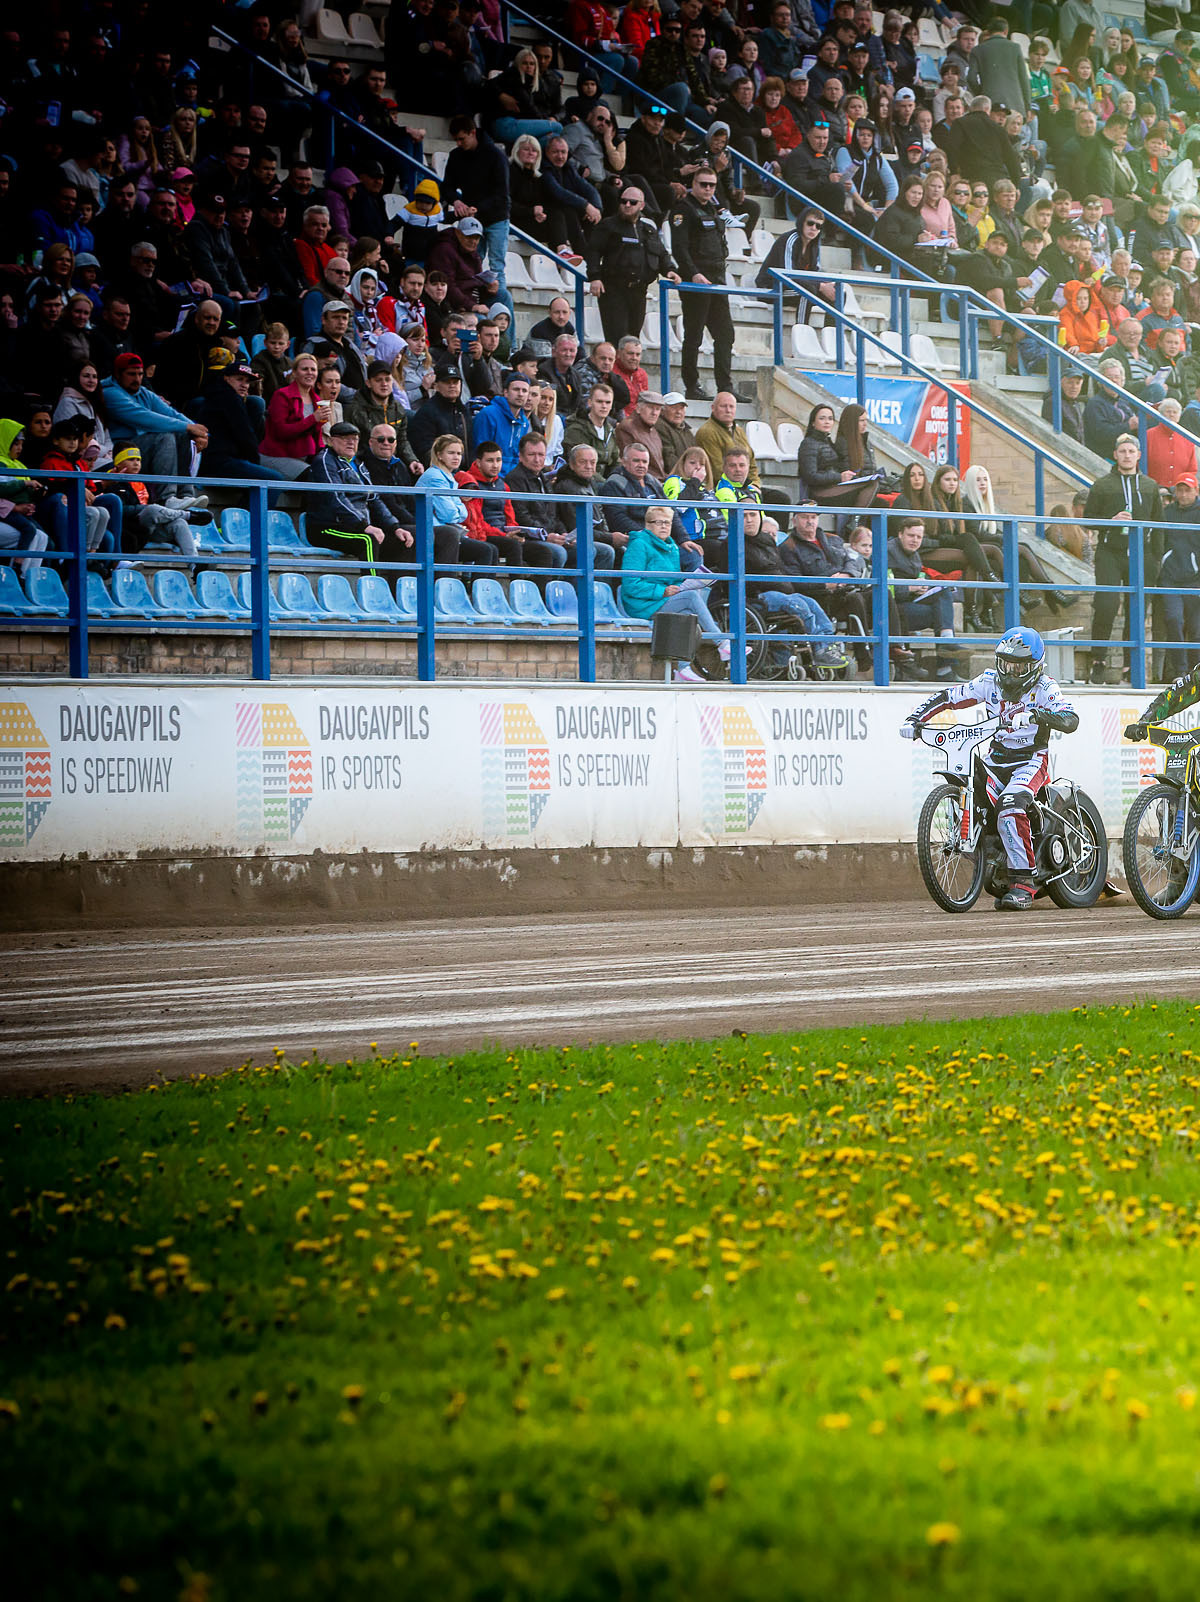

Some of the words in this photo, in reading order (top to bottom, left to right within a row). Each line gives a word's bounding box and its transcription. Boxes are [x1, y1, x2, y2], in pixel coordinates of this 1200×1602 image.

[60, 705, 180, 742] DAUGAVPILS
[320, 705, 429, 740] DAUGAVPILS
[556, 706, 656, 740] DAUGAVPILS
[772, 708, 867, 740] DAUGAVPILS
[948, 728, 984, 740] OPTIBET
[61, 758, 77, 794] IS
[84, 757, 172, 794] SPEEDWAY
[321, 755, 336, 790] IR
[343, 755, 401, 790] SPORTS
[558, 754, 572, 787] IS
[577, 754, 651, 787] SPEEDWAY
[774, 755, 787, 786] IR
[792, 754, 843, 786] SPORTS
